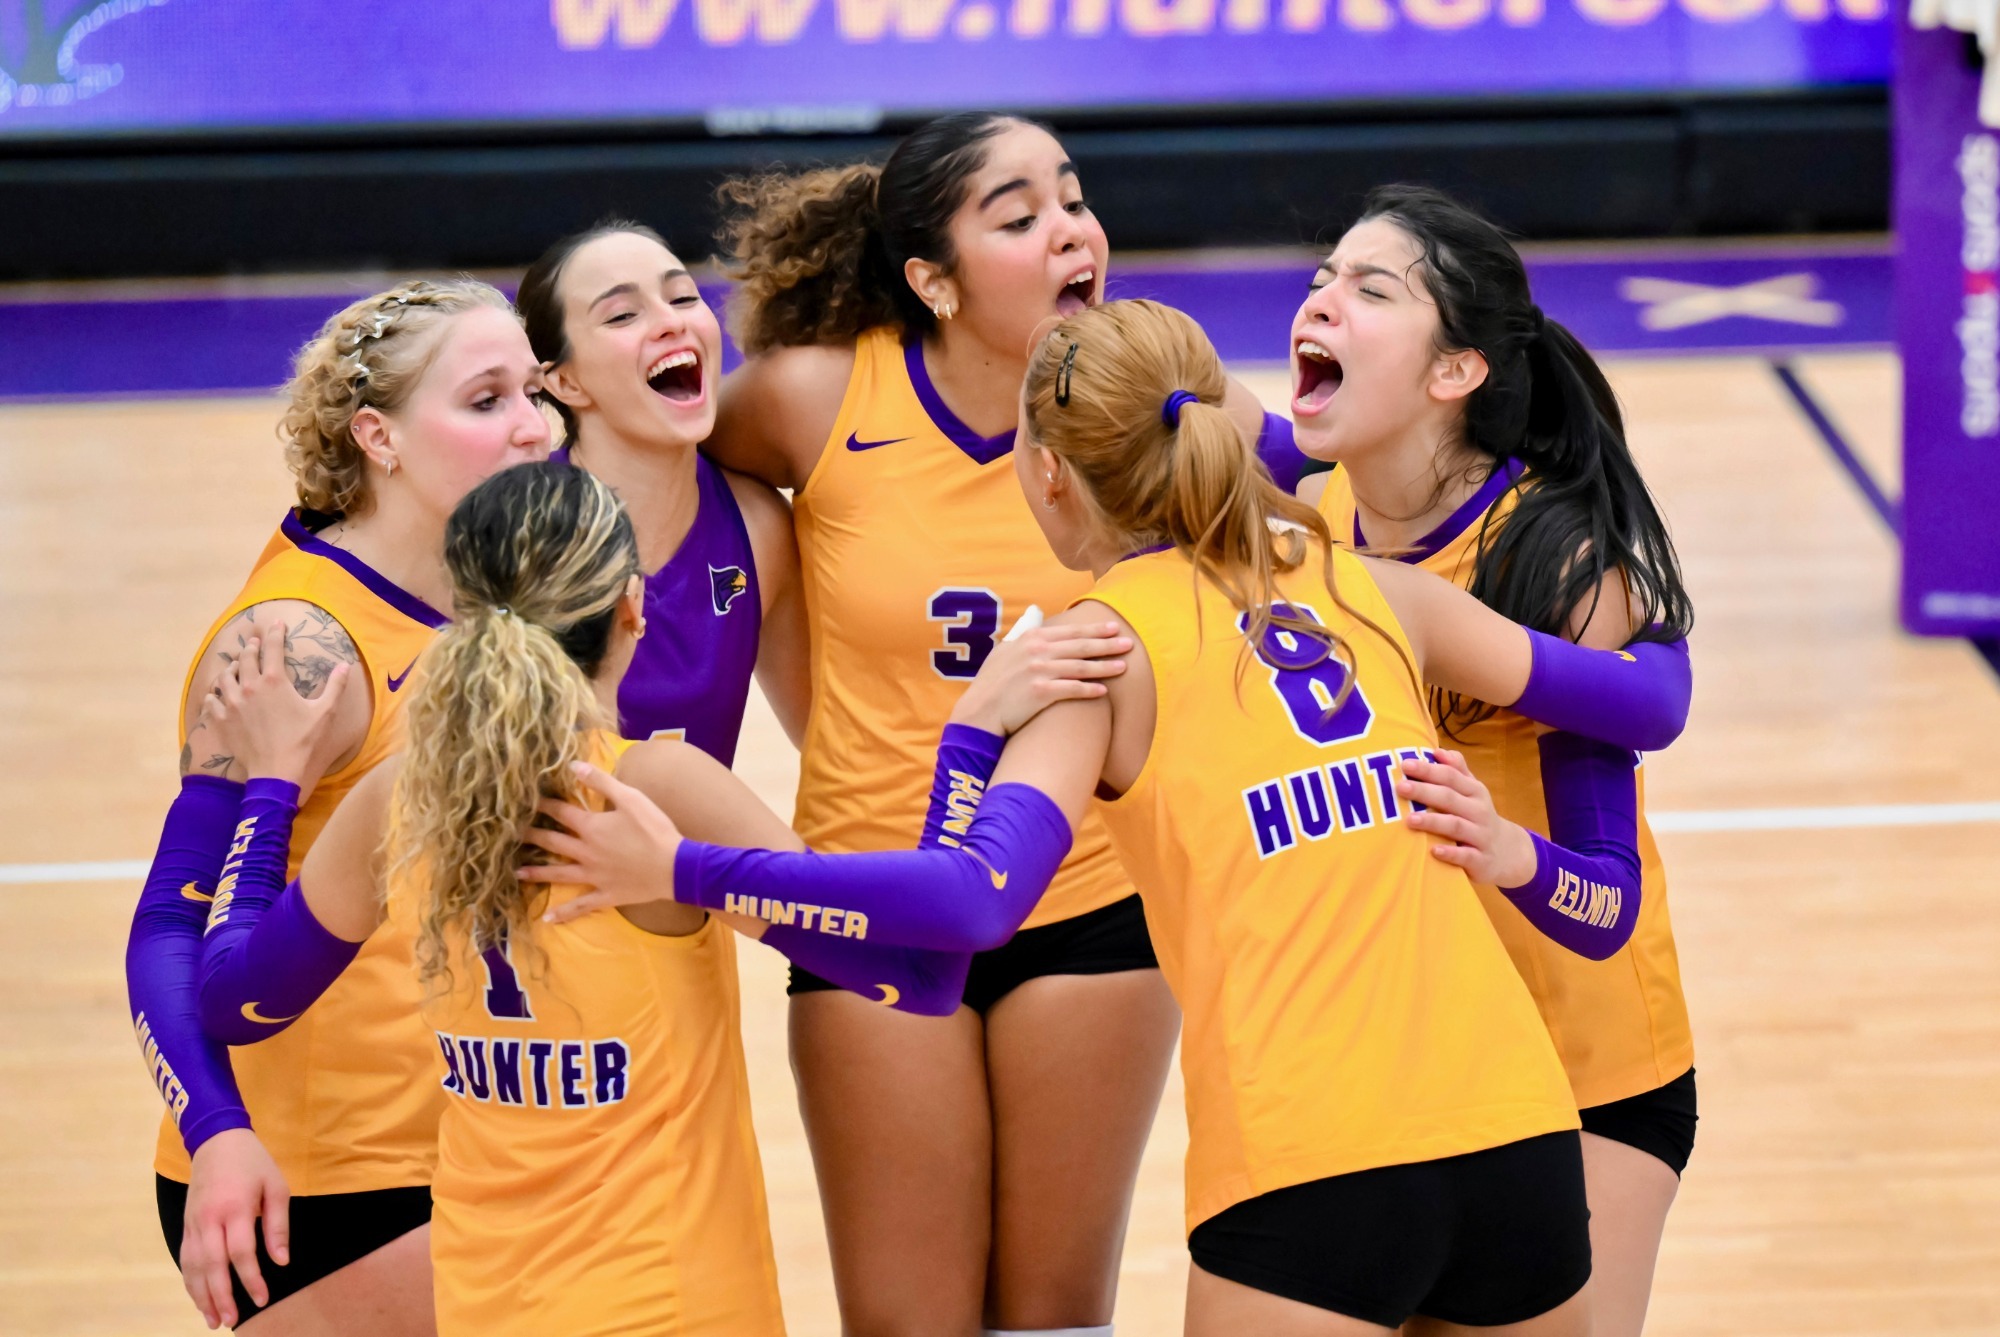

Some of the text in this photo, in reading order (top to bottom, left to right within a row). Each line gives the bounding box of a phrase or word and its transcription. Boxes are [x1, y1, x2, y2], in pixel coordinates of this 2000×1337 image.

[926, 586, 1003, 681] 3
[1235, 599, 1375, 748] 8
[1241, 746, 1440, 861] HUNT
[724, 892, 869, 941] HUNTER
[1548, 866, 1623, 930] HUNTER
[434, 1030, 632, 1109] HUNTER
